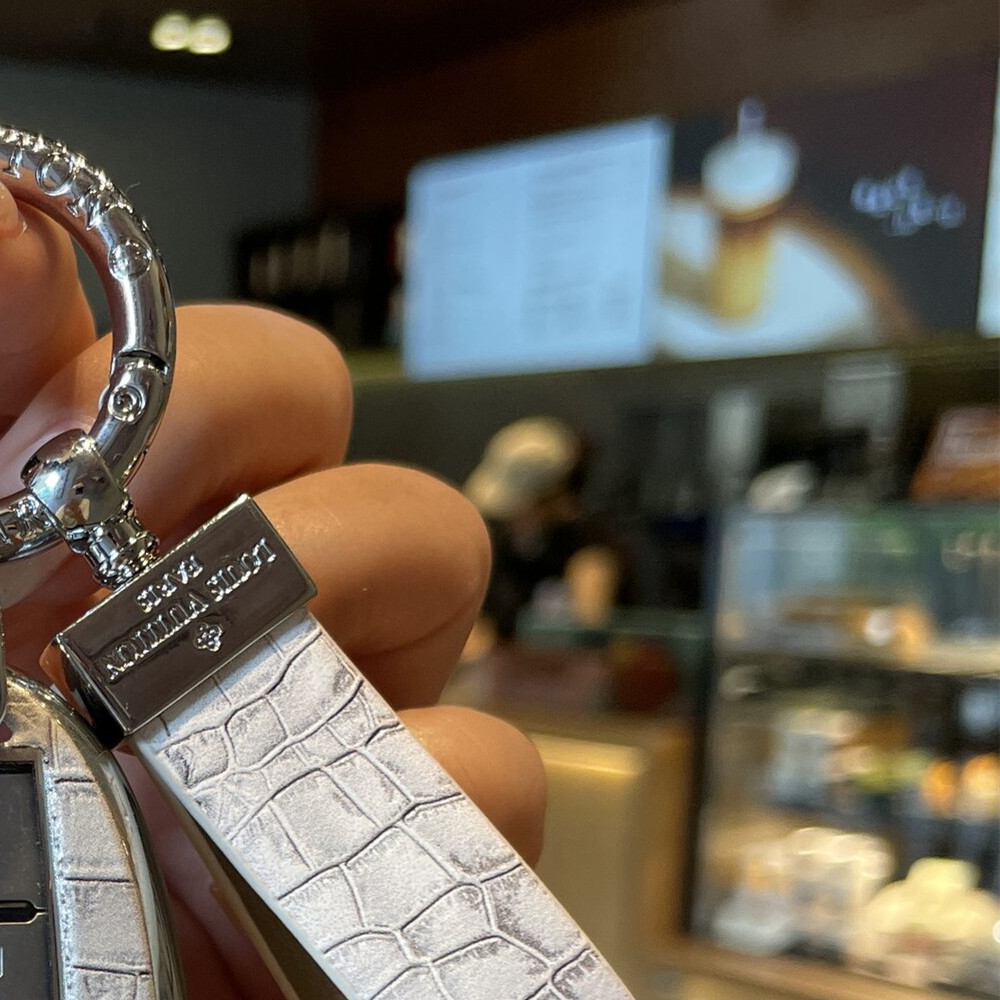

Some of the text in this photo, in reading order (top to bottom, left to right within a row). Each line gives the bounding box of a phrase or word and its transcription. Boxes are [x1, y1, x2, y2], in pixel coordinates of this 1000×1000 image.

[98, 536, 277, 682] LOUIS VUITTON
[136, 553, 204, 613] PARIS
